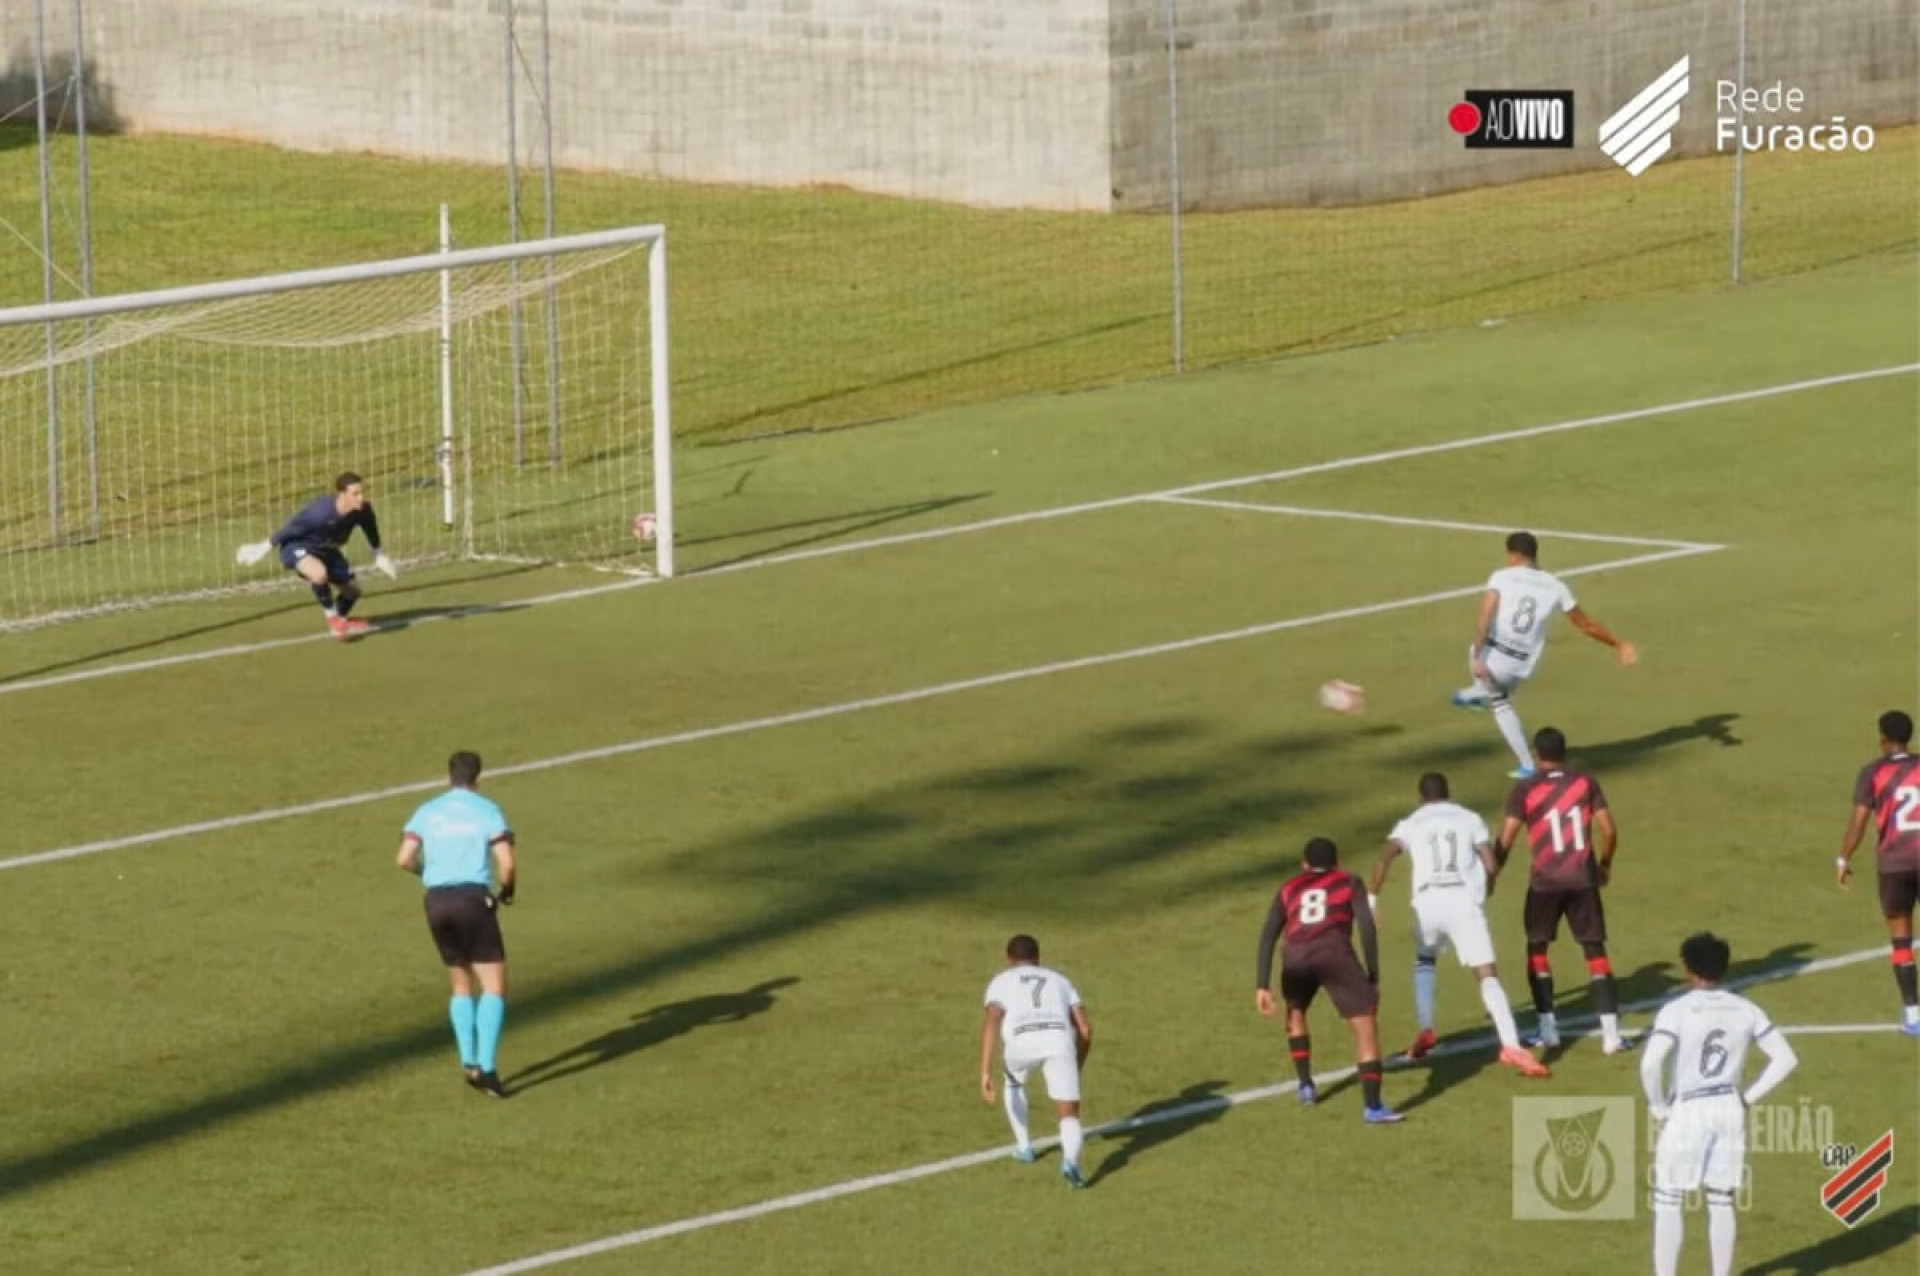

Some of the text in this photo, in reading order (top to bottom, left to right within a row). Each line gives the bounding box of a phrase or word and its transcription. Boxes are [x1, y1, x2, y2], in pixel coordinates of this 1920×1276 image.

[1511, 595, 1537, 634] 8
[1543, 806, 1585, 852] 11
[1894, 786, 1920, 831] 2
[1427, 831, 1459, 872] 11
[1300, 889, 1326, 924] 8
[1020, 974, 1047, 1009] 7
[1699, 1028, 1728, 1079] 6
